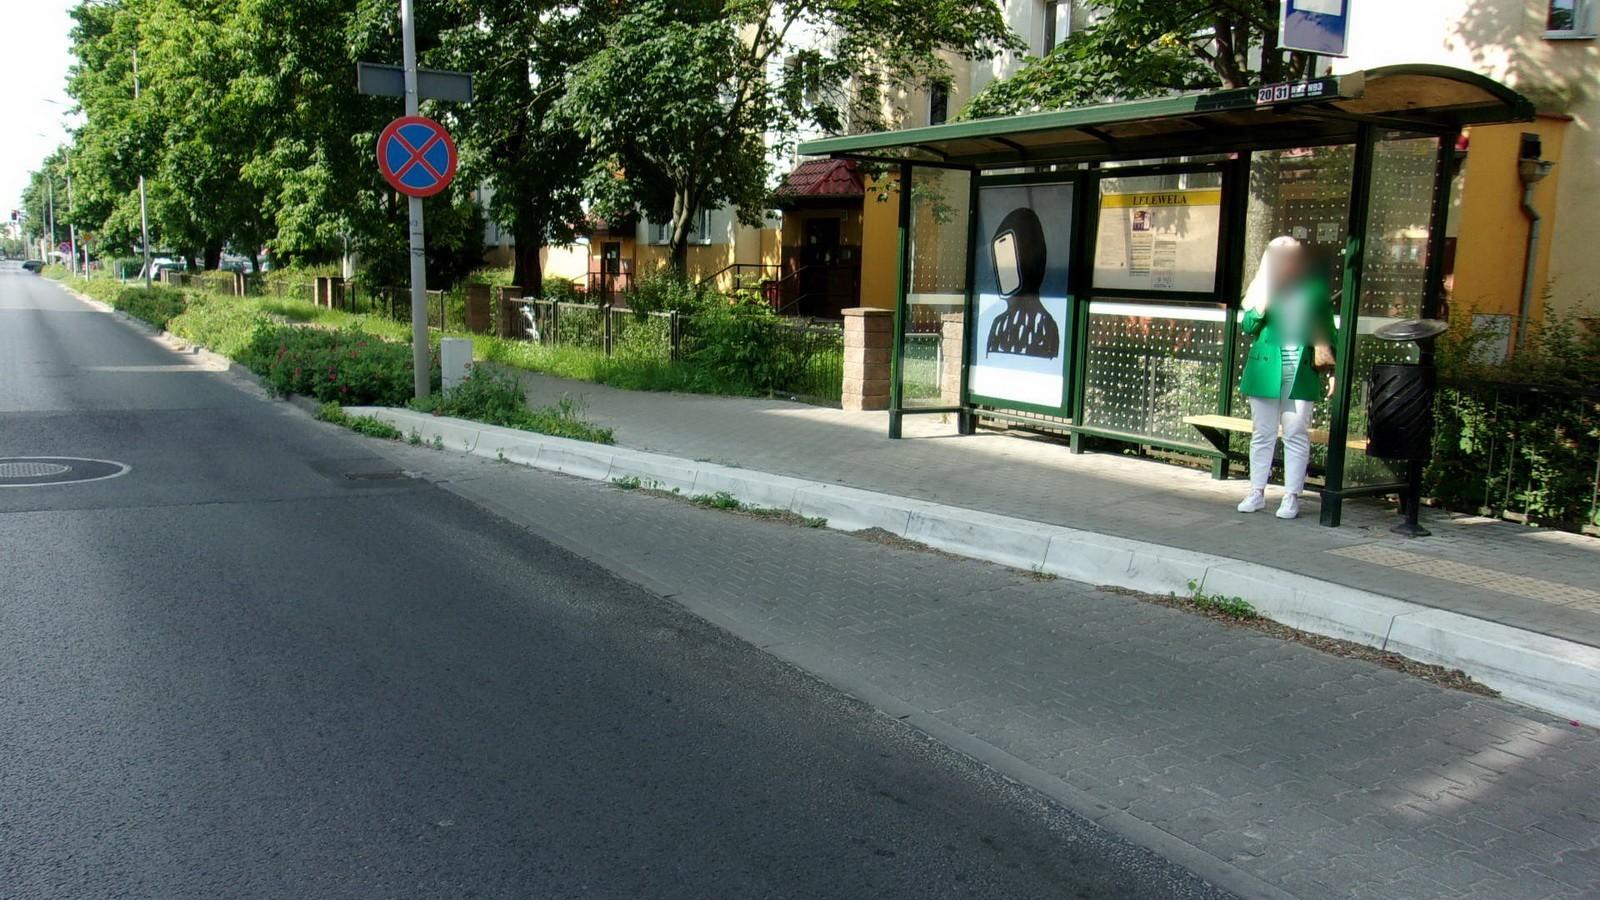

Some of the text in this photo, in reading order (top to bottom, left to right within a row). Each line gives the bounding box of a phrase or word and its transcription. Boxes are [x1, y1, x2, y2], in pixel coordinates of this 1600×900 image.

[1260, 90, 1272, 101] 20
[1276, 88, 1288, 99] 31
[1133, 194, 1186, 205] LELEWELA
